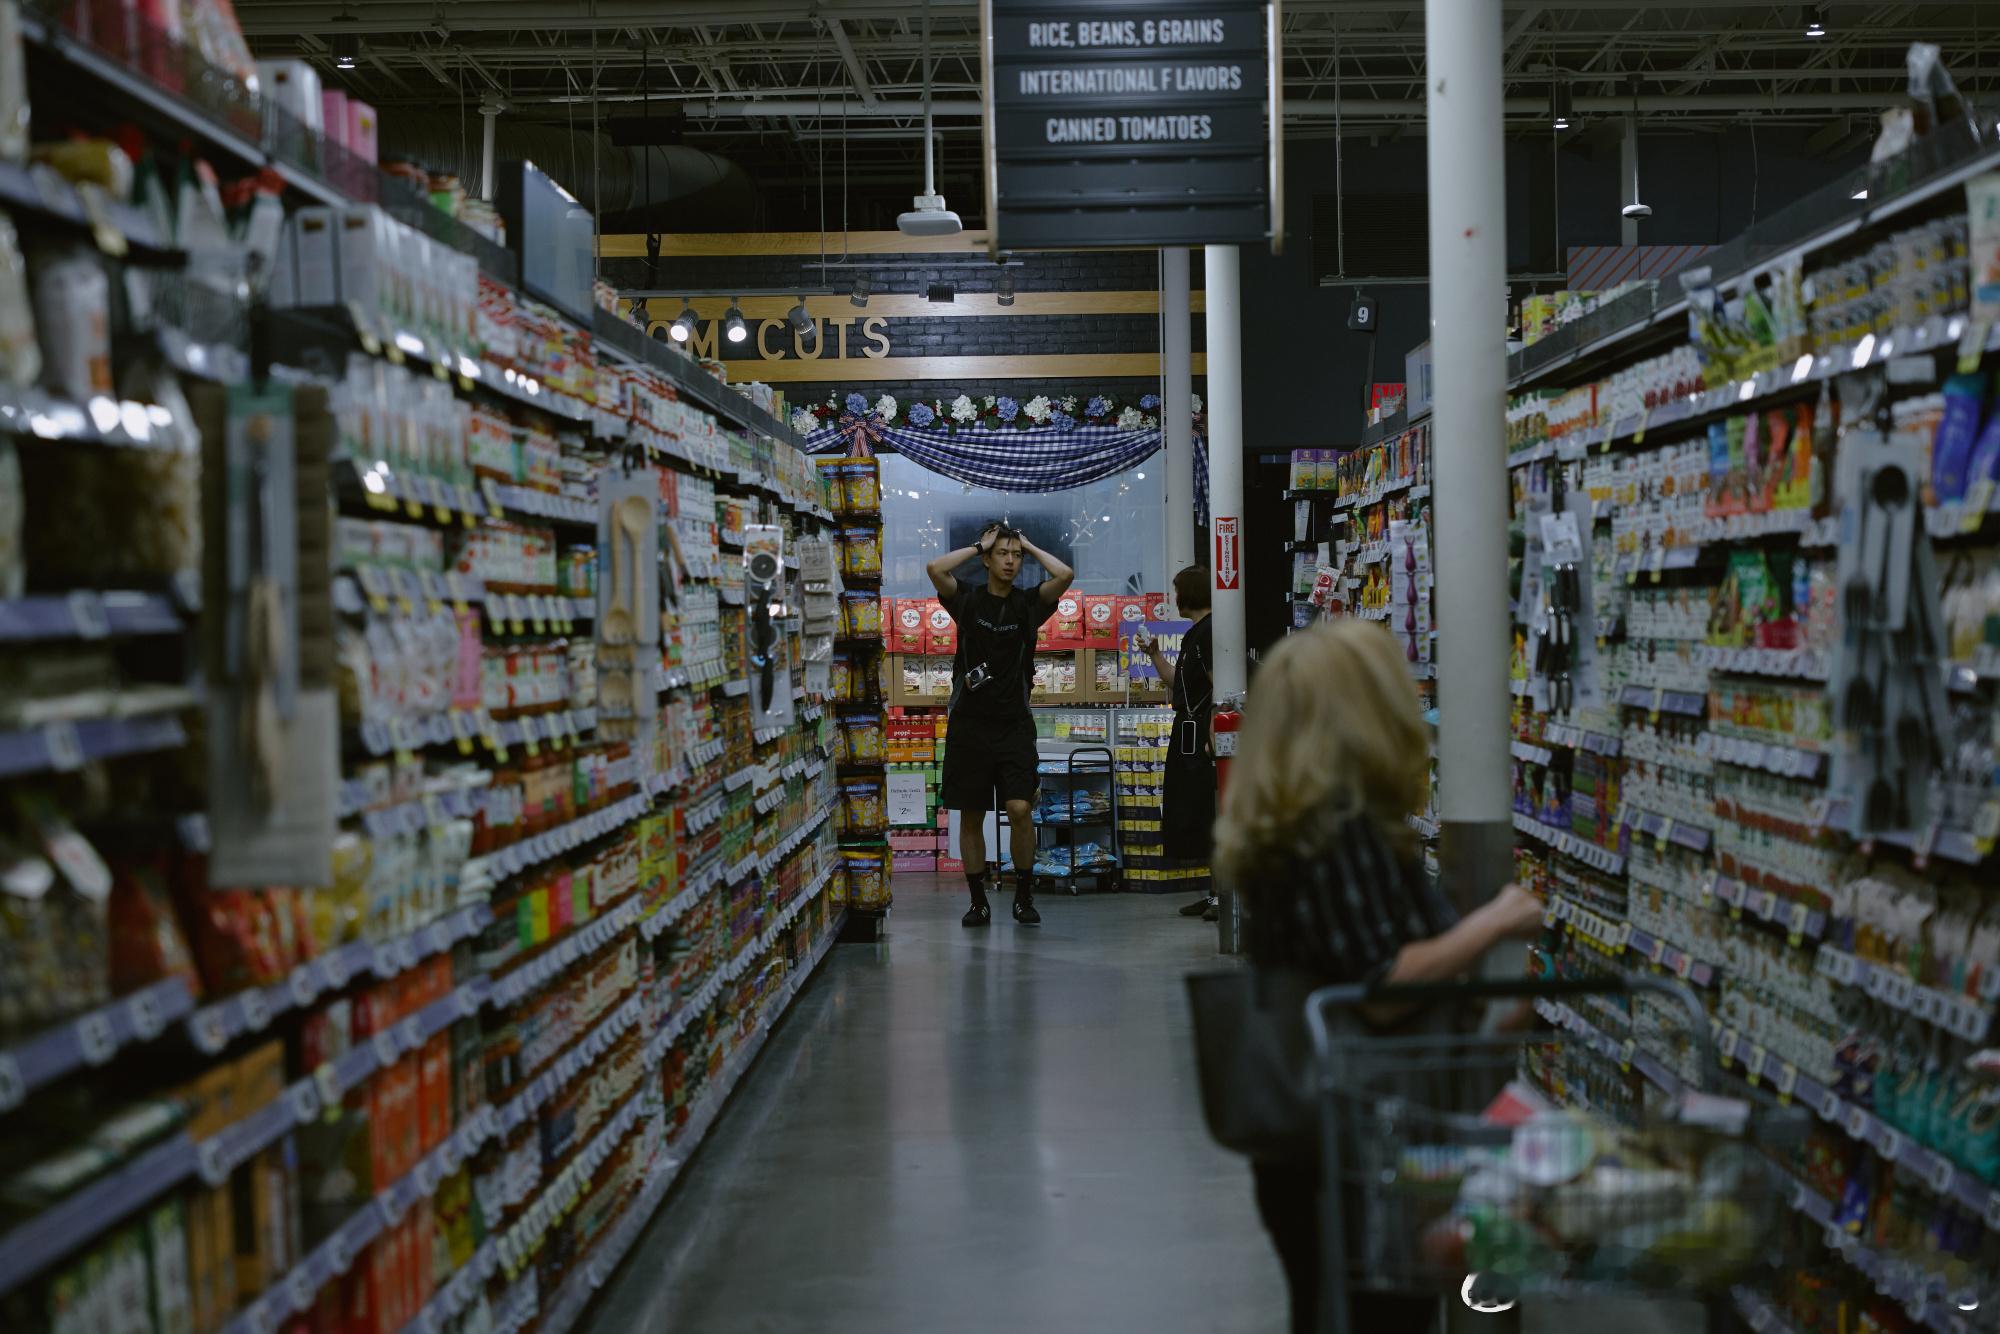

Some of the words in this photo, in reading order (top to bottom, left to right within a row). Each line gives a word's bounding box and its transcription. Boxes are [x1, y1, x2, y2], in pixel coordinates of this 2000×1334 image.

[1029, 22, 1075, 48] RICE,
[1077, 20, 1140, 47] BEANS,
[1143, 20, 1157, 44] &
[1158, 18, 1225, 45] GRAINS
[1019, 68, 1158, 95] INTERNATIONAL
[1160, 65, 1242, 92] FLAVORS
[1046, 117, 1117, 143] CANNED
[1119, 115, 1212, 142] TOMATOES
[1357, 306, 1369, 324] 9
[645, 318, 720, 361] OM
[757, 316, 891, 361] CUTS
[1219, 523, 1235, 533] FIRE
[893, 729, 911, 737] poppi
